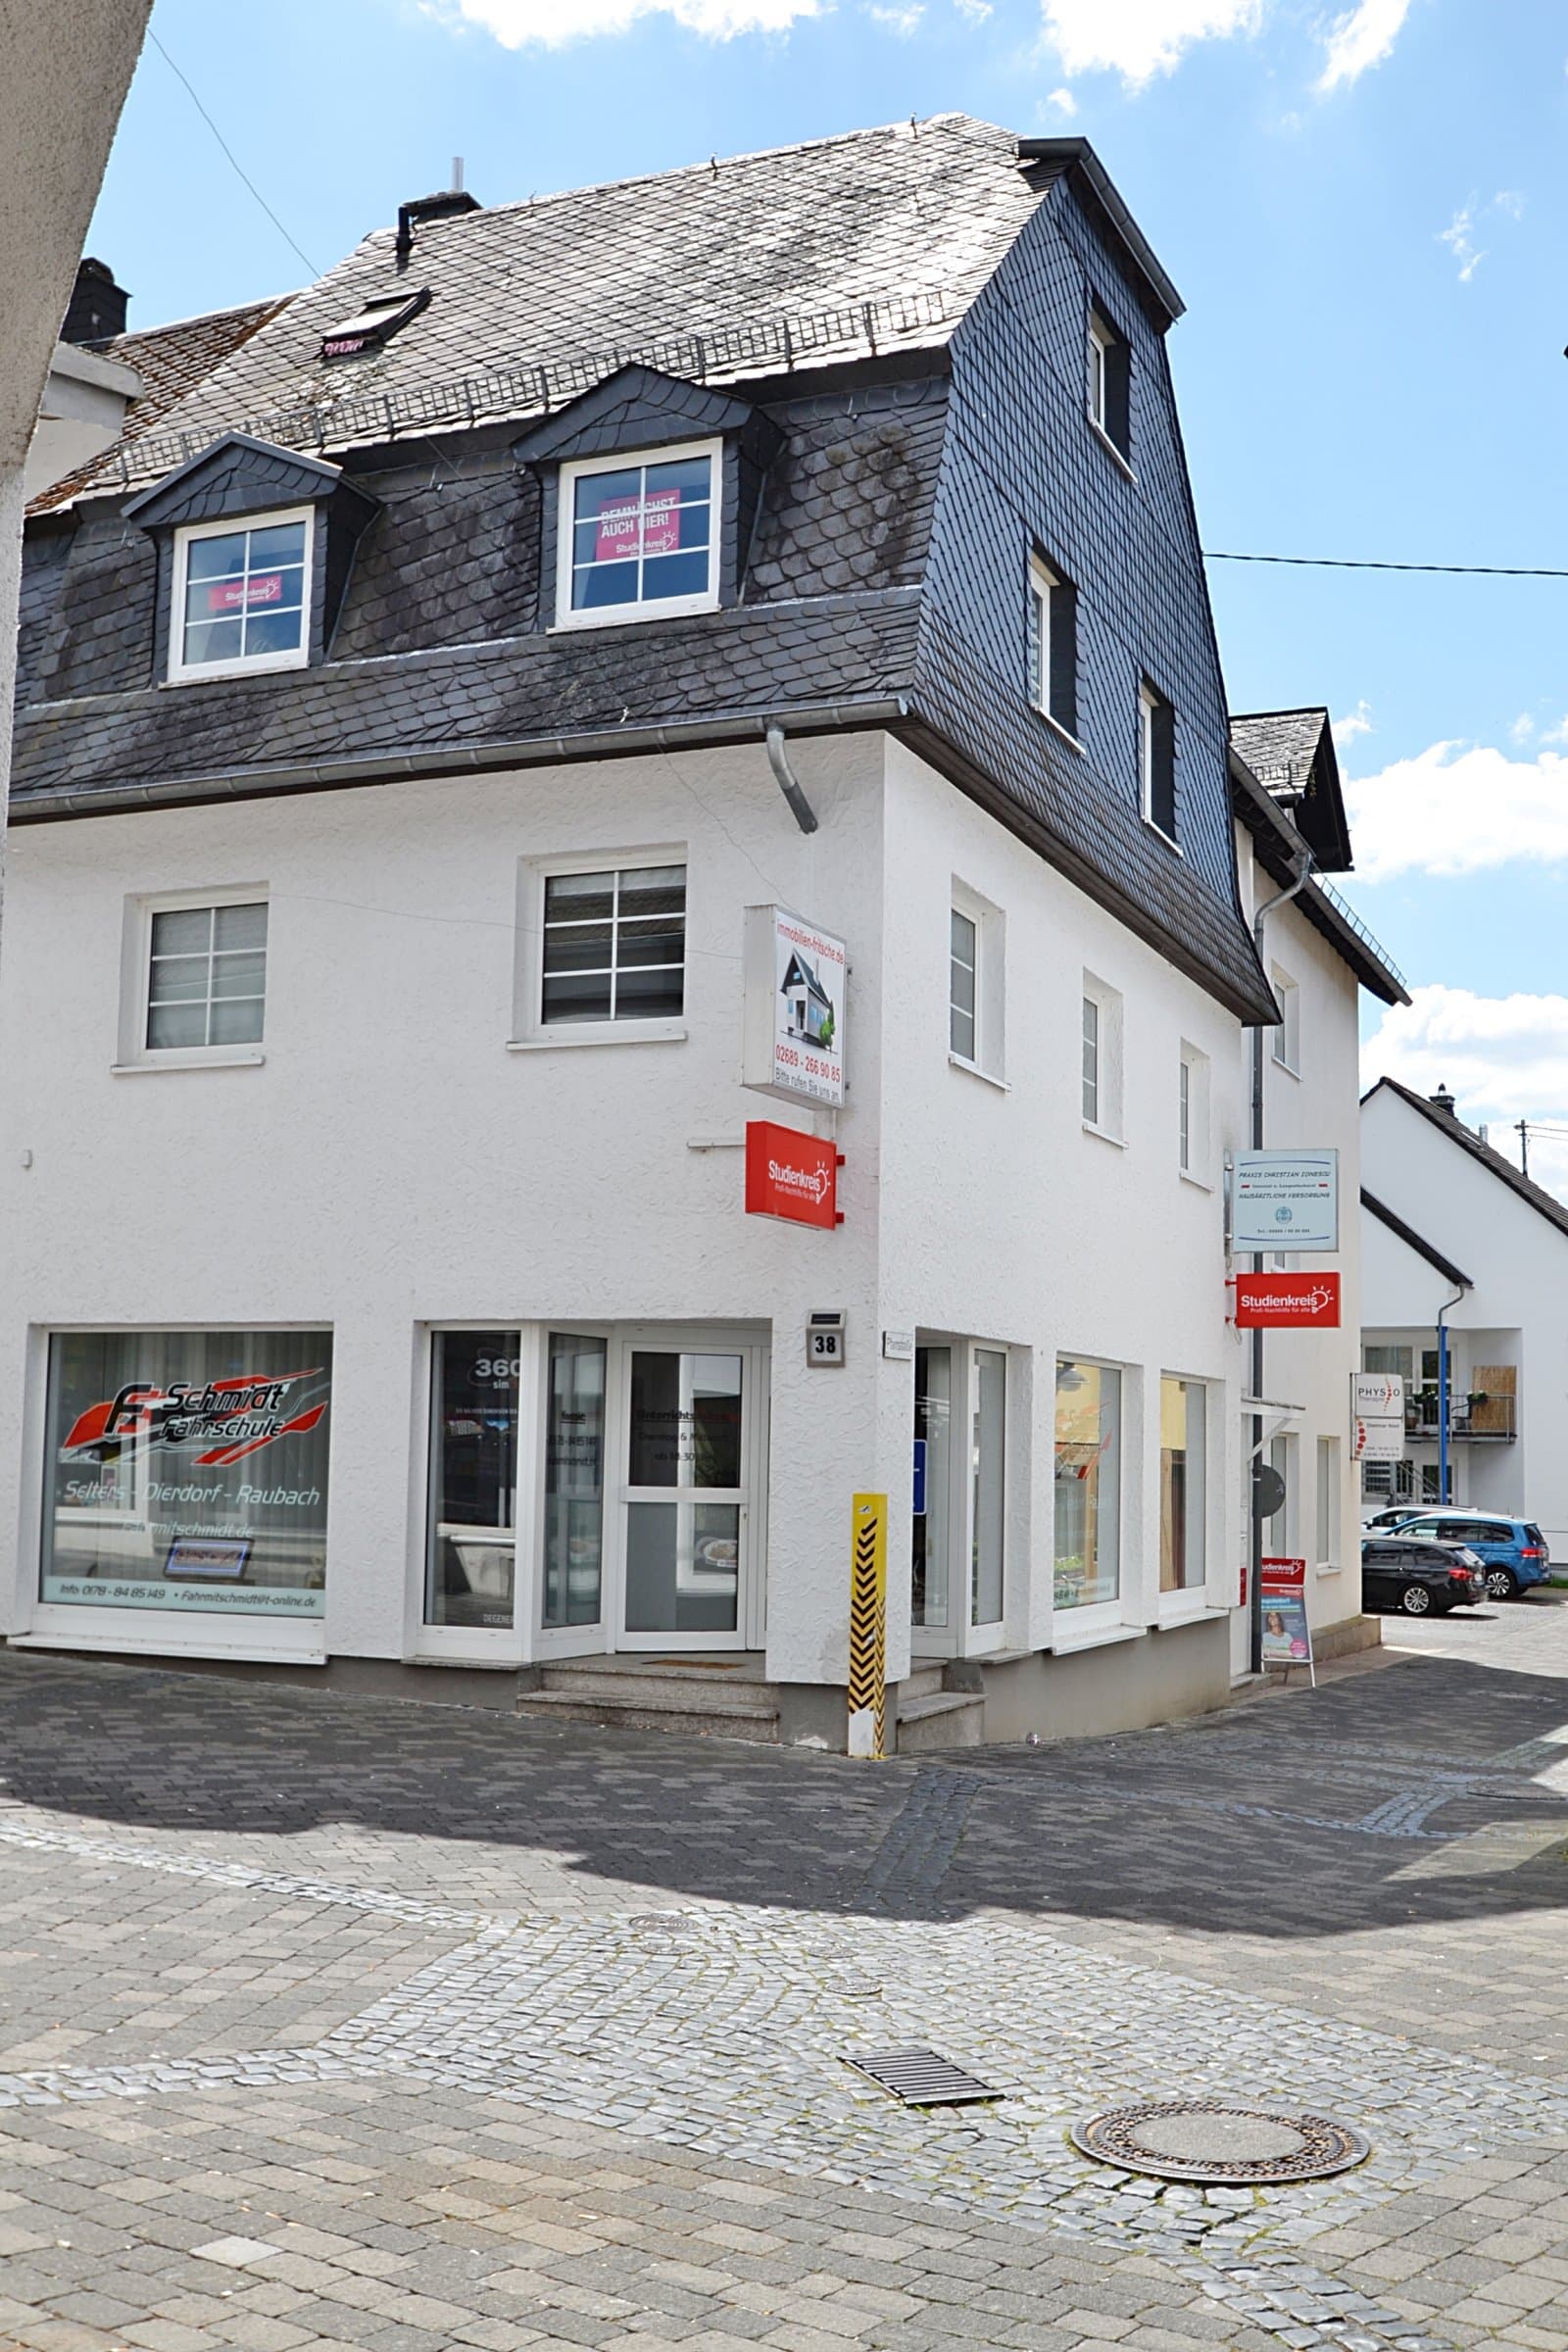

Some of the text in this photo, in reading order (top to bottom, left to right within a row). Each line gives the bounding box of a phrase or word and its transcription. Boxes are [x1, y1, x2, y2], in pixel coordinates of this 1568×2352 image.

[601, 518, 634, 539] AUCH
[775, 1044, 799, 1067] 02689
[805, 1055, 819, 1075] 266
[820, 1061, 830, 1079] 90
[831, 1066, 841, 1083] 85
[768, 1159, 821, 1192] Studienkreis
[1240, 1294, 1318, 1308] Studienkreis
[814, 1335, 836, 1354] 38
[162, 1382, 285, 1412] Schmidt
[160, 1414, 285, 1439] Fahrschule
[66, 1481, 125, 1501] Selters
[145, 1483, 224, 1502] Dierdorf
[236, 1485, 320, 1506] Raubach
